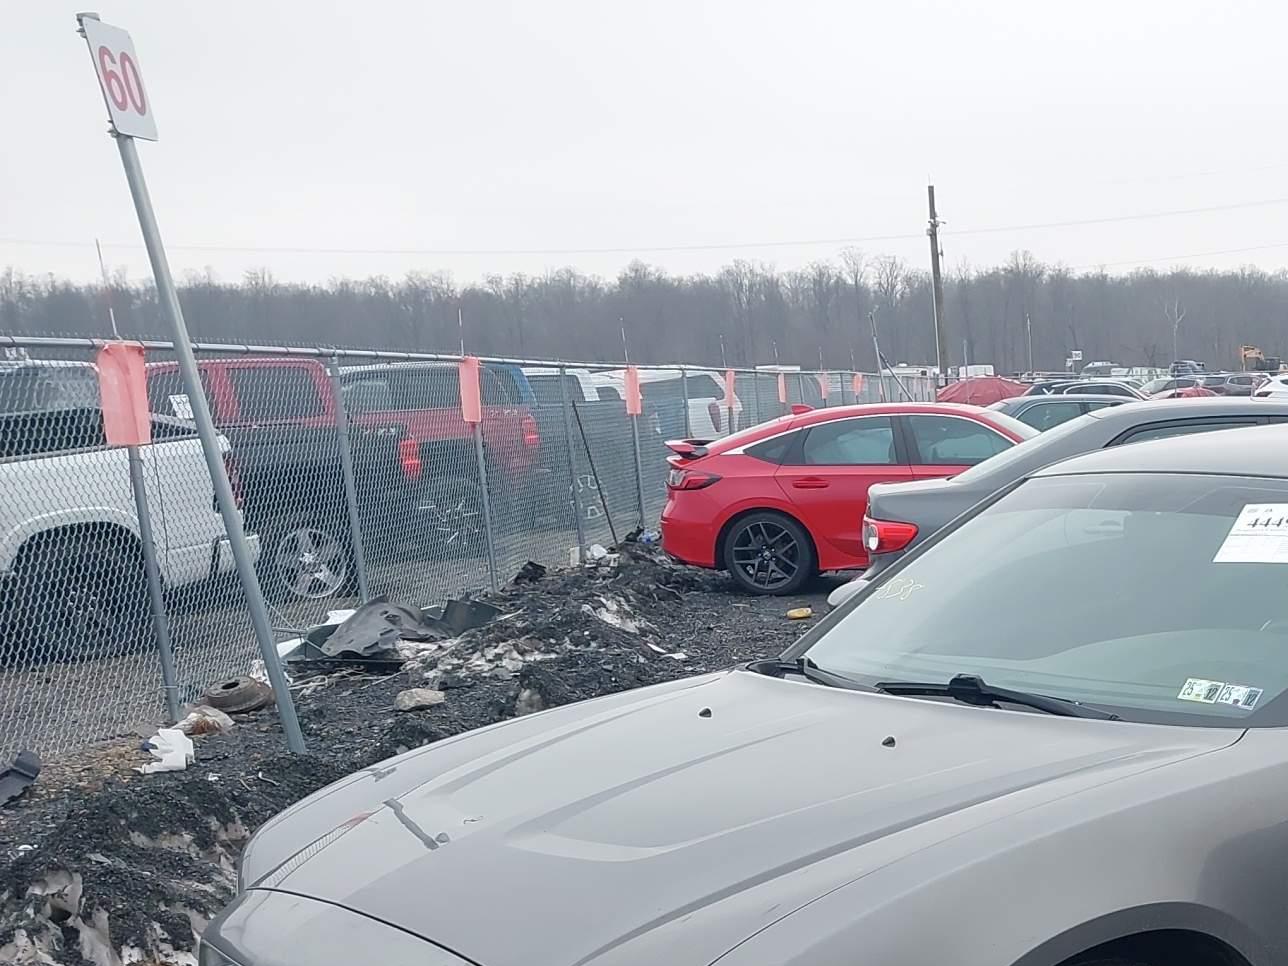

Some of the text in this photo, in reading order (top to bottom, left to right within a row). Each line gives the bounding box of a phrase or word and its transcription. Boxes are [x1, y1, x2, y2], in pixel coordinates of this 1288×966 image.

[98, 46, 146, 117] 60
[1204, 687, 1219, 701] 12
[1243, 693, 1258, 707] 12
